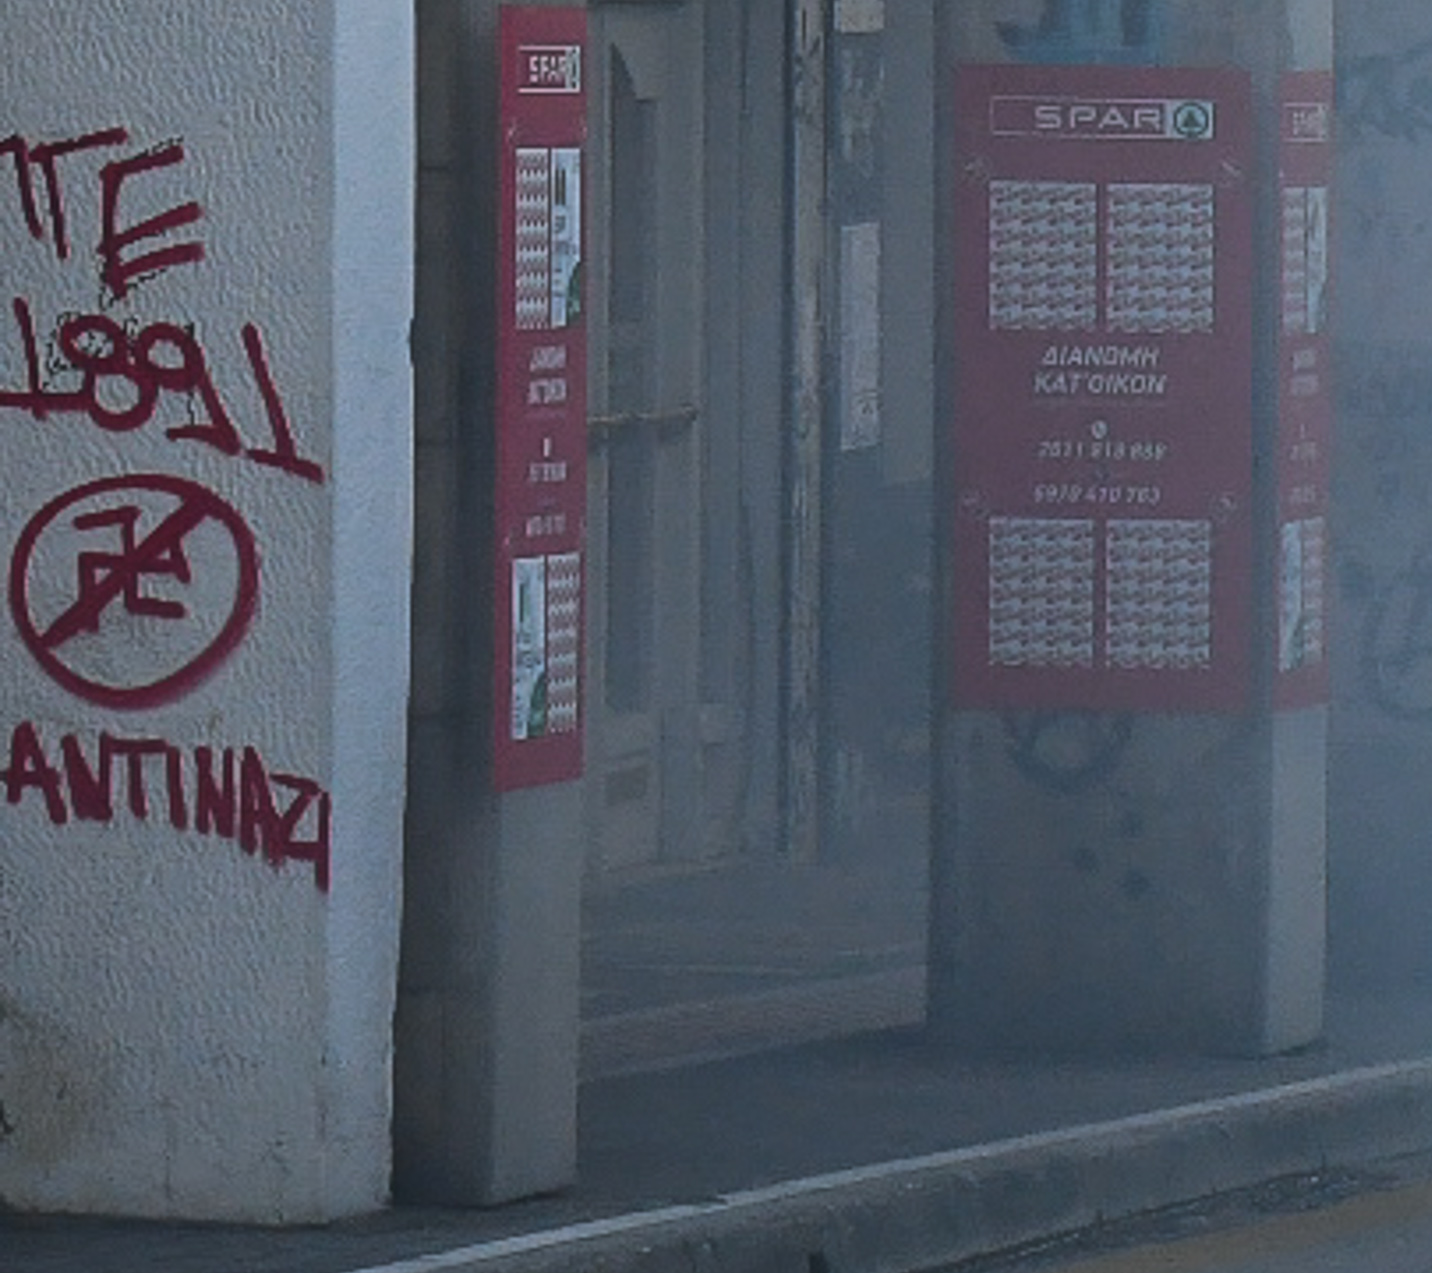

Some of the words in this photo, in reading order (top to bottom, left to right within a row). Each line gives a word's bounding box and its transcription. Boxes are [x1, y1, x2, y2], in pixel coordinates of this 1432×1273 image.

[1033, 105, 1166, 129] SPAR
[1042, 345, 1160, 367] ΔΙΑΝΟΜΗ
[0, 721, 331, 892] ANTINAZI
